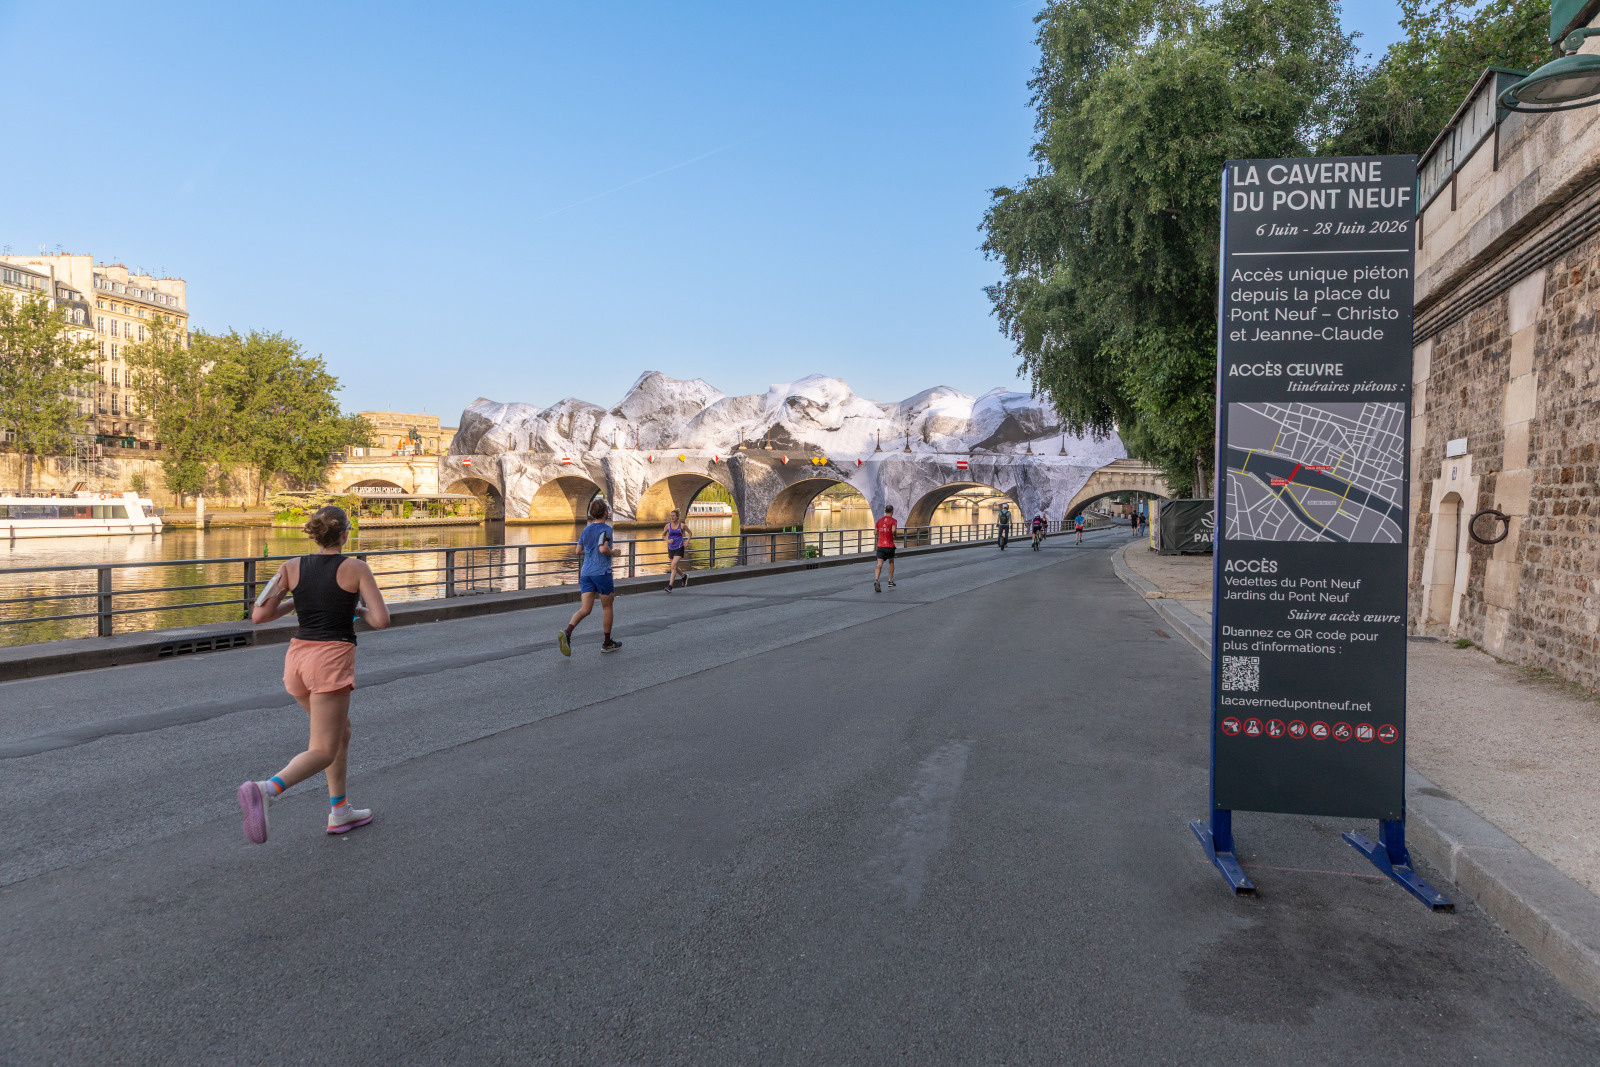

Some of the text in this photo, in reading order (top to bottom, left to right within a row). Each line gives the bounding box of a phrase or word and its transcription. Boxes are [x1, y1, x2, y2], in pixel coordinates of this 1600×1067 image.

[1233, 162, 1381, 186] LA CAVERNE
[1234, 187, 1410, 211] DU PONT NEUF
[1256, 223, 1267, 236] 6
[1268, 223, 1298, 236] Juin
[1313, 222, 1332, 234] 28
[1334, 222, 1365, 235] Juin
[1369, 220, 1409, 233] 2026
[1231, 266, 1408, 283] Accès unique piéton
[1231, 286, 1389, 304] depuis la place du
[1231, 308, 1269, 321] Pont
[1275, 307, 1317, 320] Neuf
[1337, 306, 1398, 320] Christo
[1230, 327, 1383, 341] et Jeanne-Claude
[1229, 361, 1343, 376] ACCÈS ŒUVRE
[1287, 381, 1350, 391] Itinéraires
[1352, 381, 1397, 394] piétons
[1225, 558, 1277, 573] ACCÈS
[1225, 576, 1361, 589] Vedettes du Pont Neuf
[1224, 590, 1349, 602] Jardins du Pont Neuf
[1288, 609, 1401, 623] Suivre accès œuvre
[1295, 629, 1312, 638] QR
[1316, 630, 1346, 640] code
[1351, 633, 1378, 642] pour
[1223, 641, 1248, 651] plus
[1222, 695, 1371, 711] lacavernedupontneuf.net
